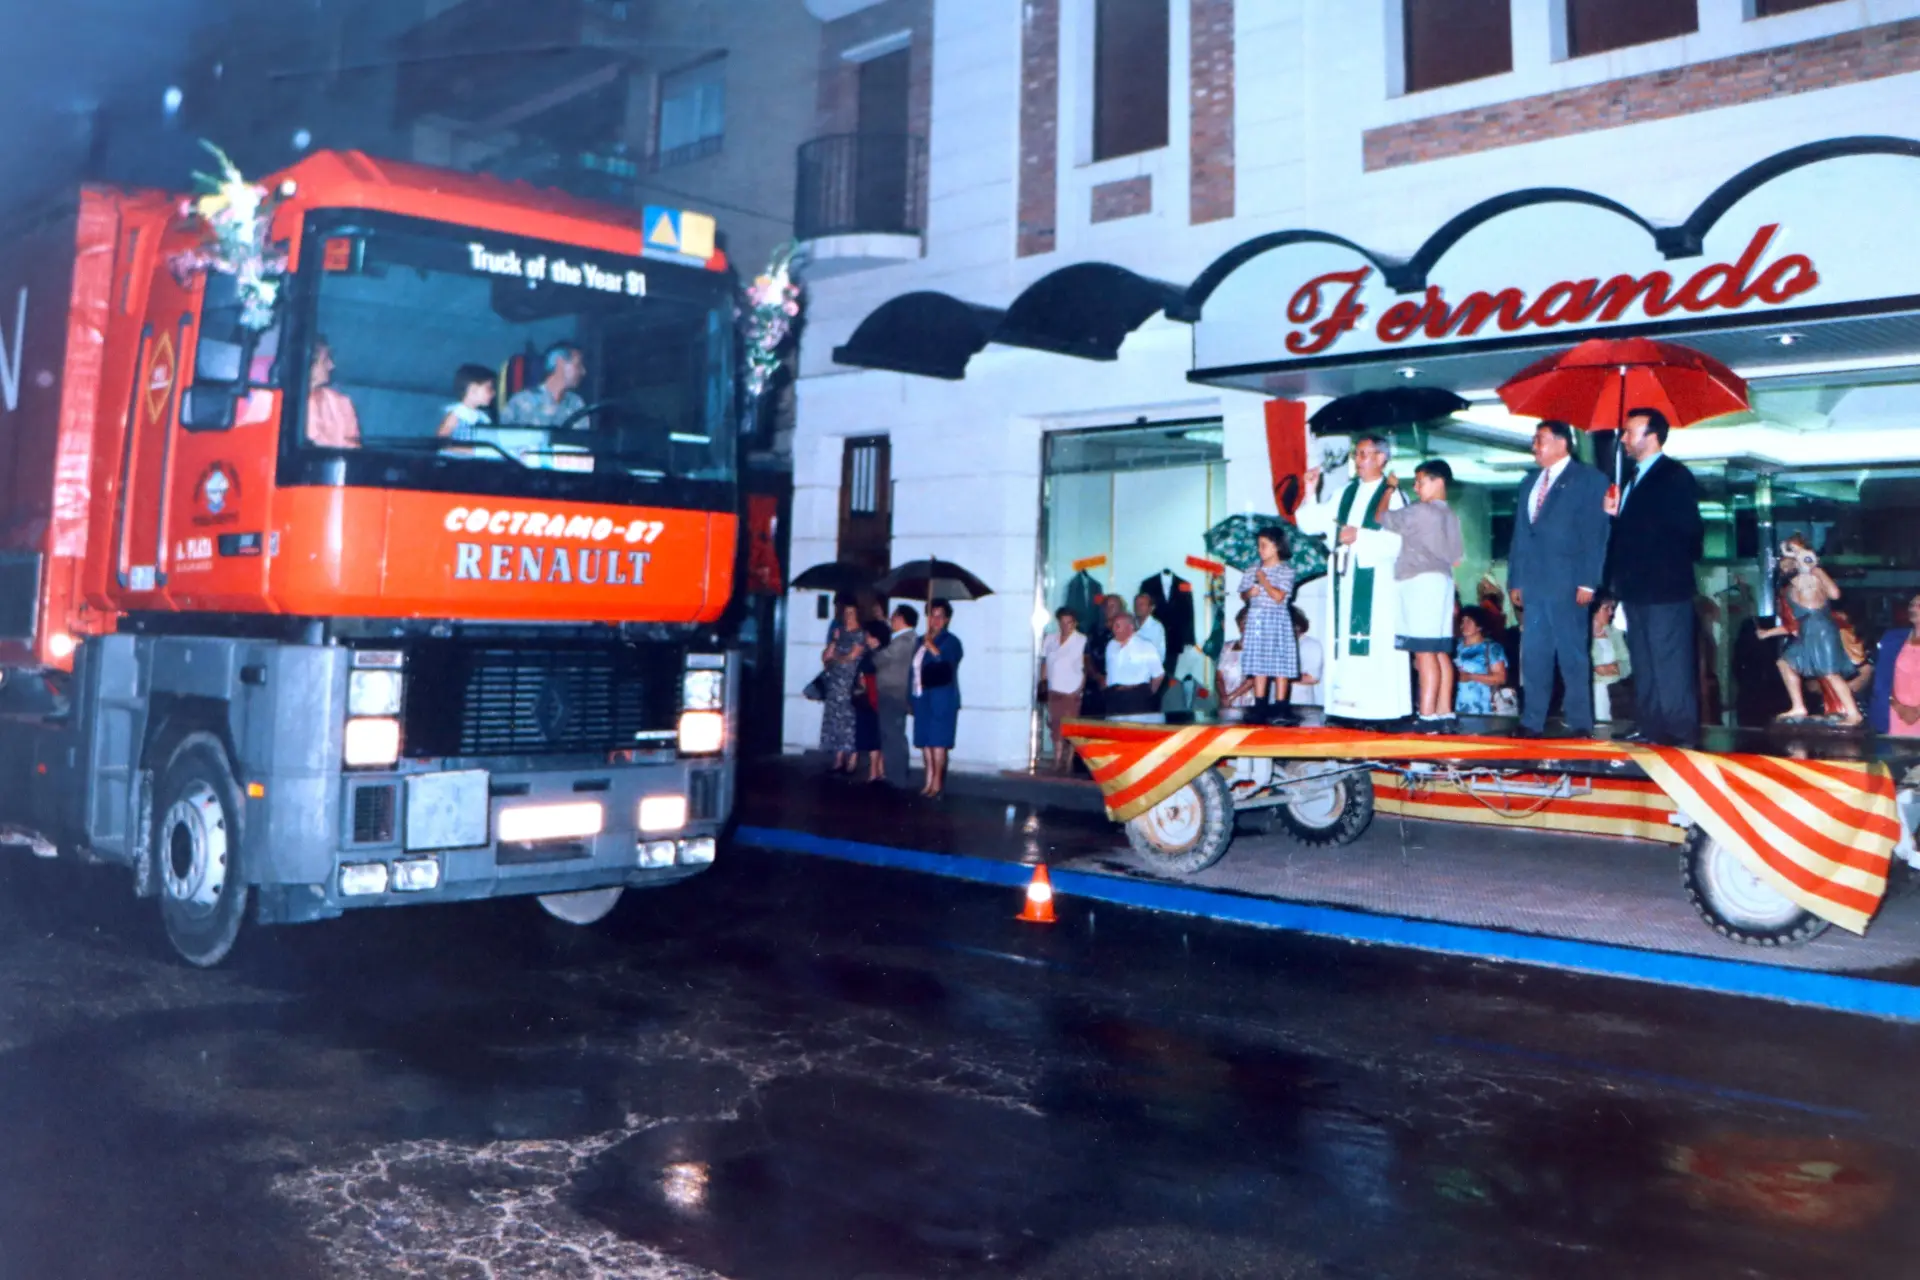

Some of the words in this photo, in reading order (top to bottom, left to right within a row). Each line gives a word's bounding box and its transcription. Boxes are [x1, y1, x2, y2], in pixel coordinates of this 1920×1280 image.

[468, 242, 522, 277] Truck
[526, 255, 546, 280] of
[551, 260, 582, 285] the
[583, 264, 623, 293] Year
[626, 270, 648, 297] 91
[1285, 223, 1819, 354] Fernando
[444, 507, 664, 544] COCTRAMO-87
[454, 542, 651, 585] RENAULT
